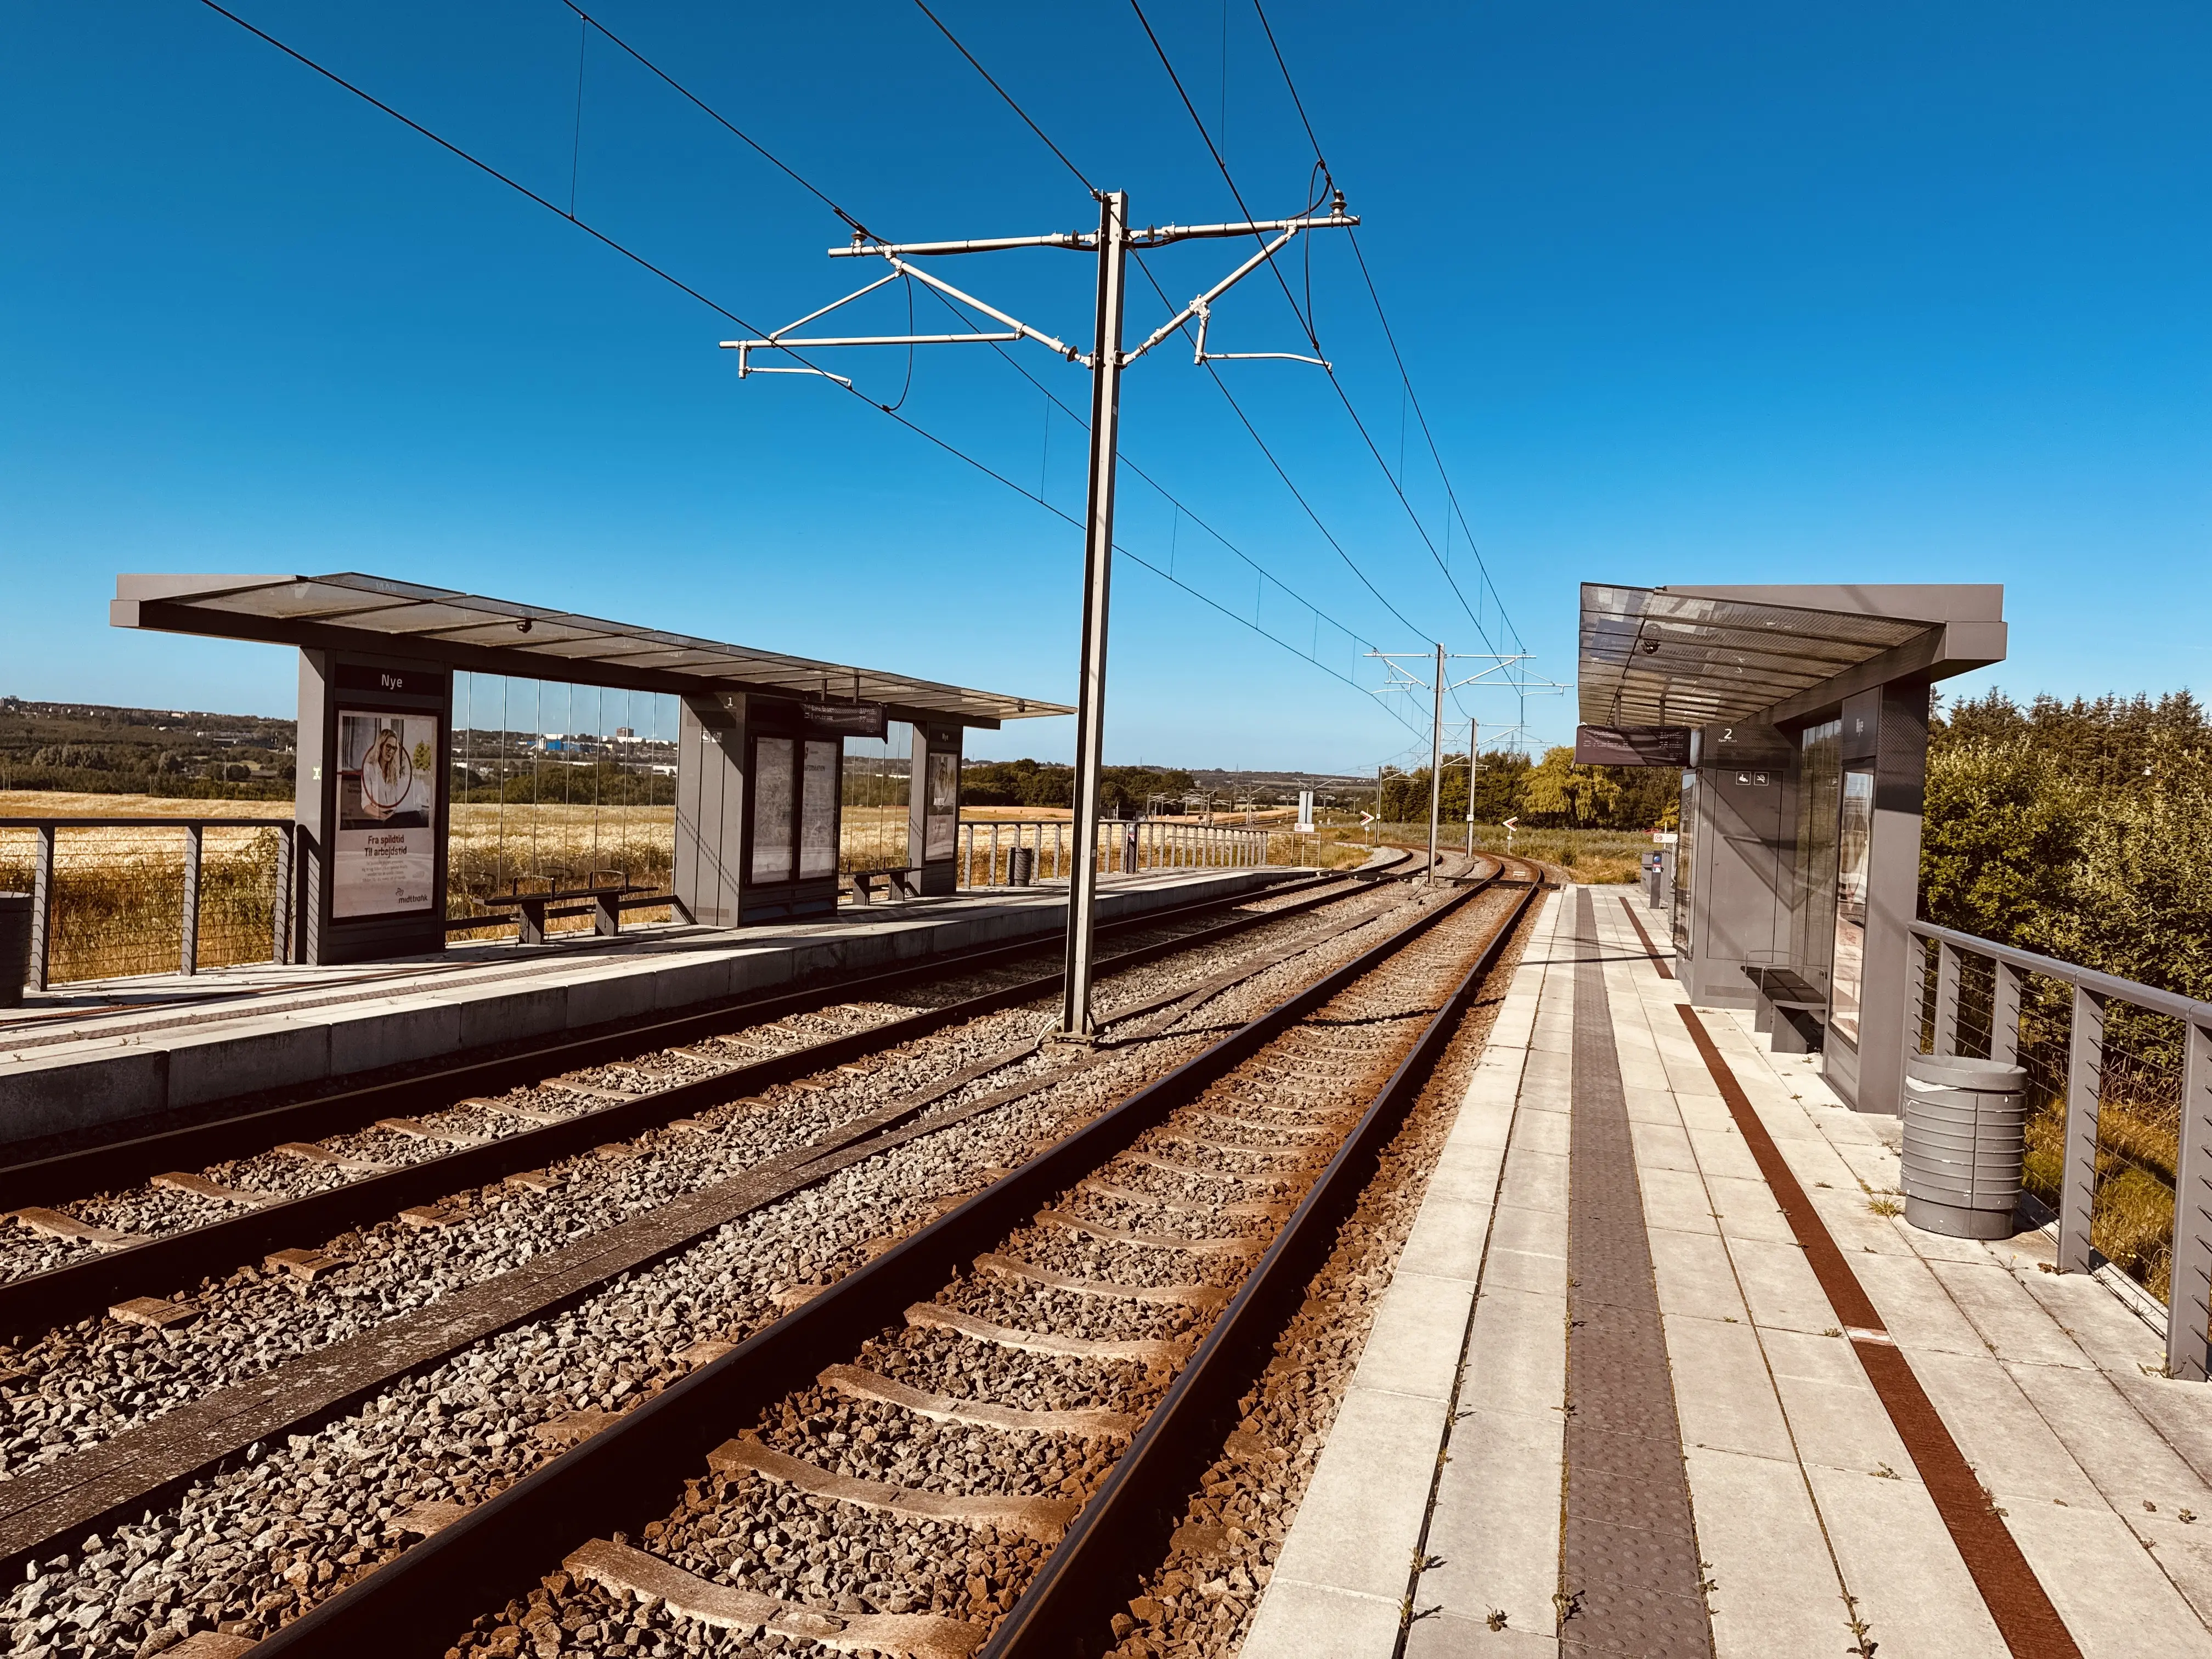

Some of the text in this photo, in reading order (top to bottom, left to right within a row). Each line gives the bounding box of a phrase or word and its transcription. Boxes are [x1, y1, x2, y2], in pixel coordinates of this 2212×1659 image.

[381, 674, 403, 690] Nye
[727, 697, 733, 707] 1
[1724, 728, 1732, 739] 2
[368, 834, 404, 847] Fra spildtid
[364, 845, 407, 858] Til arbejdstid
[398, 894, 428, 904] midttrafik
